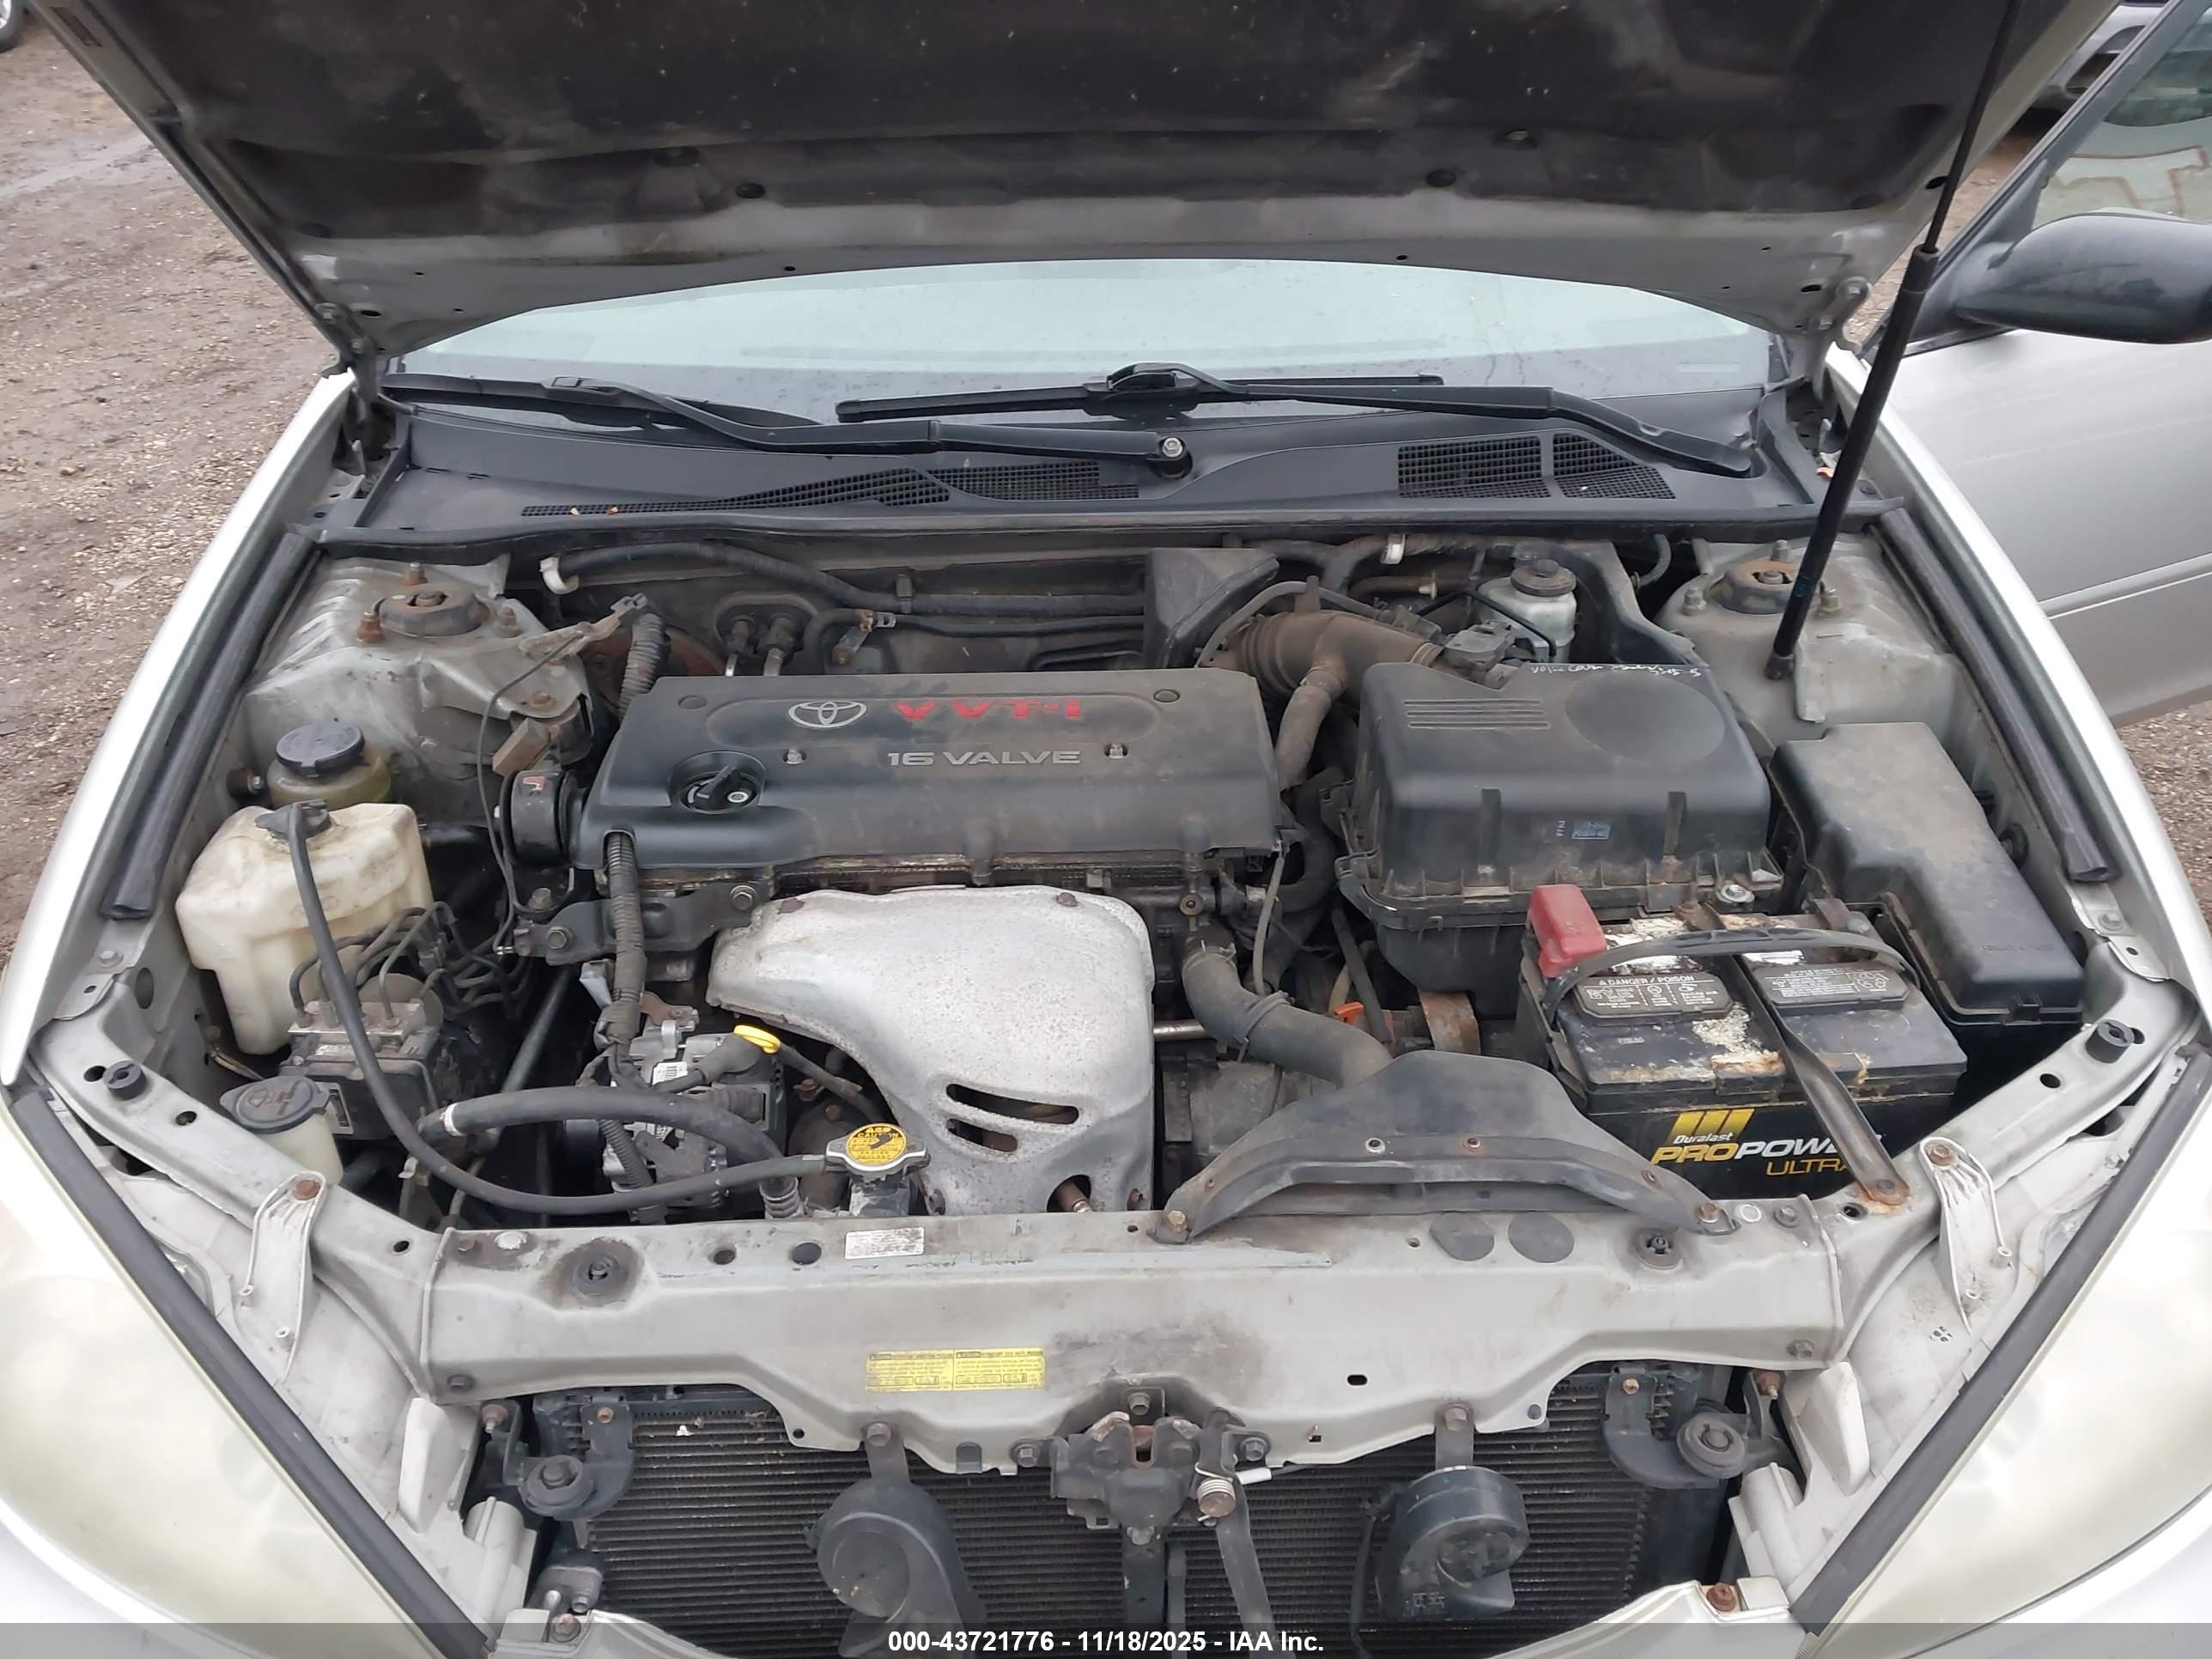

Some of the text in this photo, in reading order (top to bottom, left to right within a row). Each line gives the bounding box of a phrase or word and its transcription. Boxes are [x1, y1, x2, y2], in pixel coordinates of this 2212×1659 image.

[887, 750, 1081, 767] 16 VALVE
[1672, 1131, 1734, 1145] Duralast
